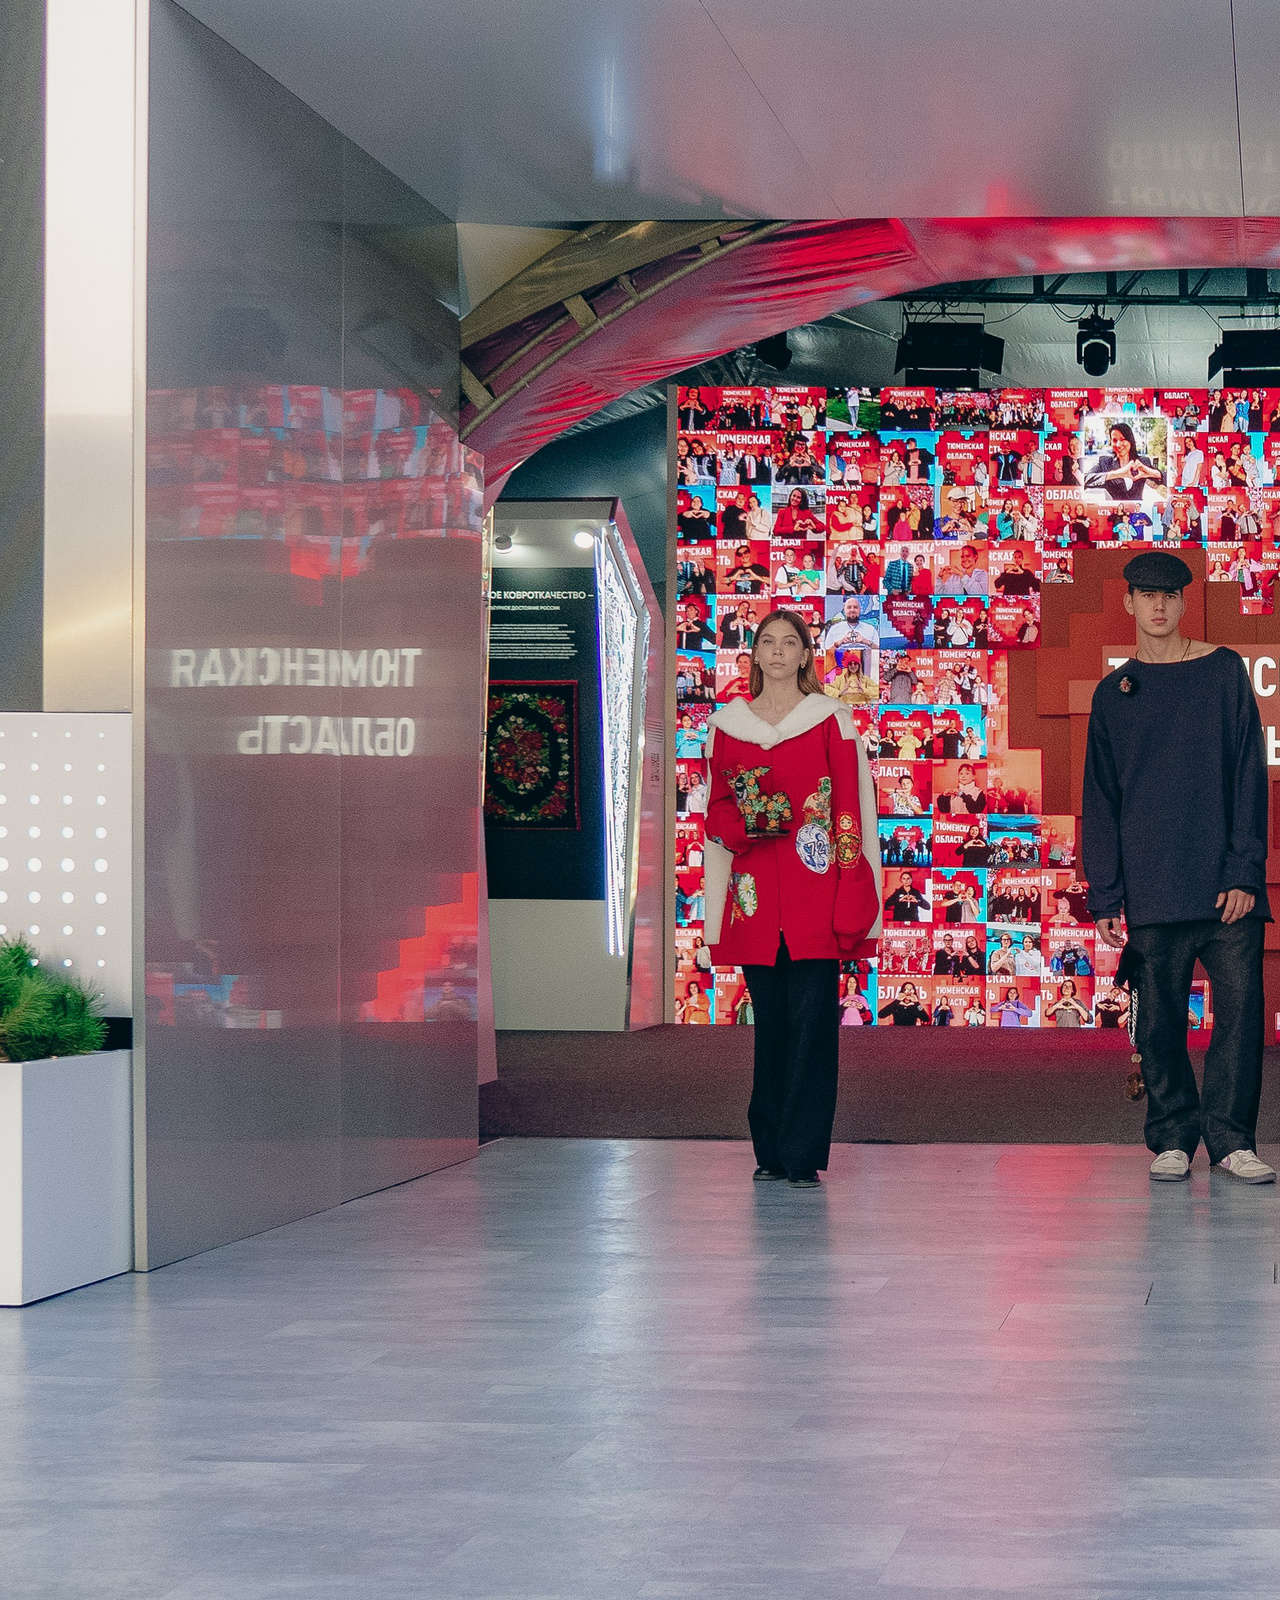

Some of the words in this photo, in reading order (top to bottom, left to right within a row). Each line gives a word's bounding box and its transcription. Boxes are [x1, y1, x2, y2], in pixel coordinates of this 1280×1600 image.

[1050, 390, 1088, 398] ТЮМЕНСКАЯ
[1050, 400, 1078, 408] ОБЛАСТЬ
[716, 434, 771, 444] ТЮМЕНСКАЯ
[946, 442, 984, 450] ТЮМЕНСКАЯ
[946, 452, 974, 460] ОБЛАСТЬ
[503, 590, 586, 600] КОВРОТКАЧЕСТВО
[939, 650, 981, 659] ТЮМЕНСКАЯ
[878, 766, 911, 777] ЛАСТЬ
[807, 840, 826, 857] 72
[1002, 877, 1040, 886] ТЮМЕНСКАЯ
[883, 929, 926, 937] ТЮМЕНСКАЯ
[1049, 928, 1094, 937] ТЮМЕНСКАЯ
[715, 974, 737, 983] СКАЯ
[936, 987, 979, 995] ТЮМЕНСКАЯ
